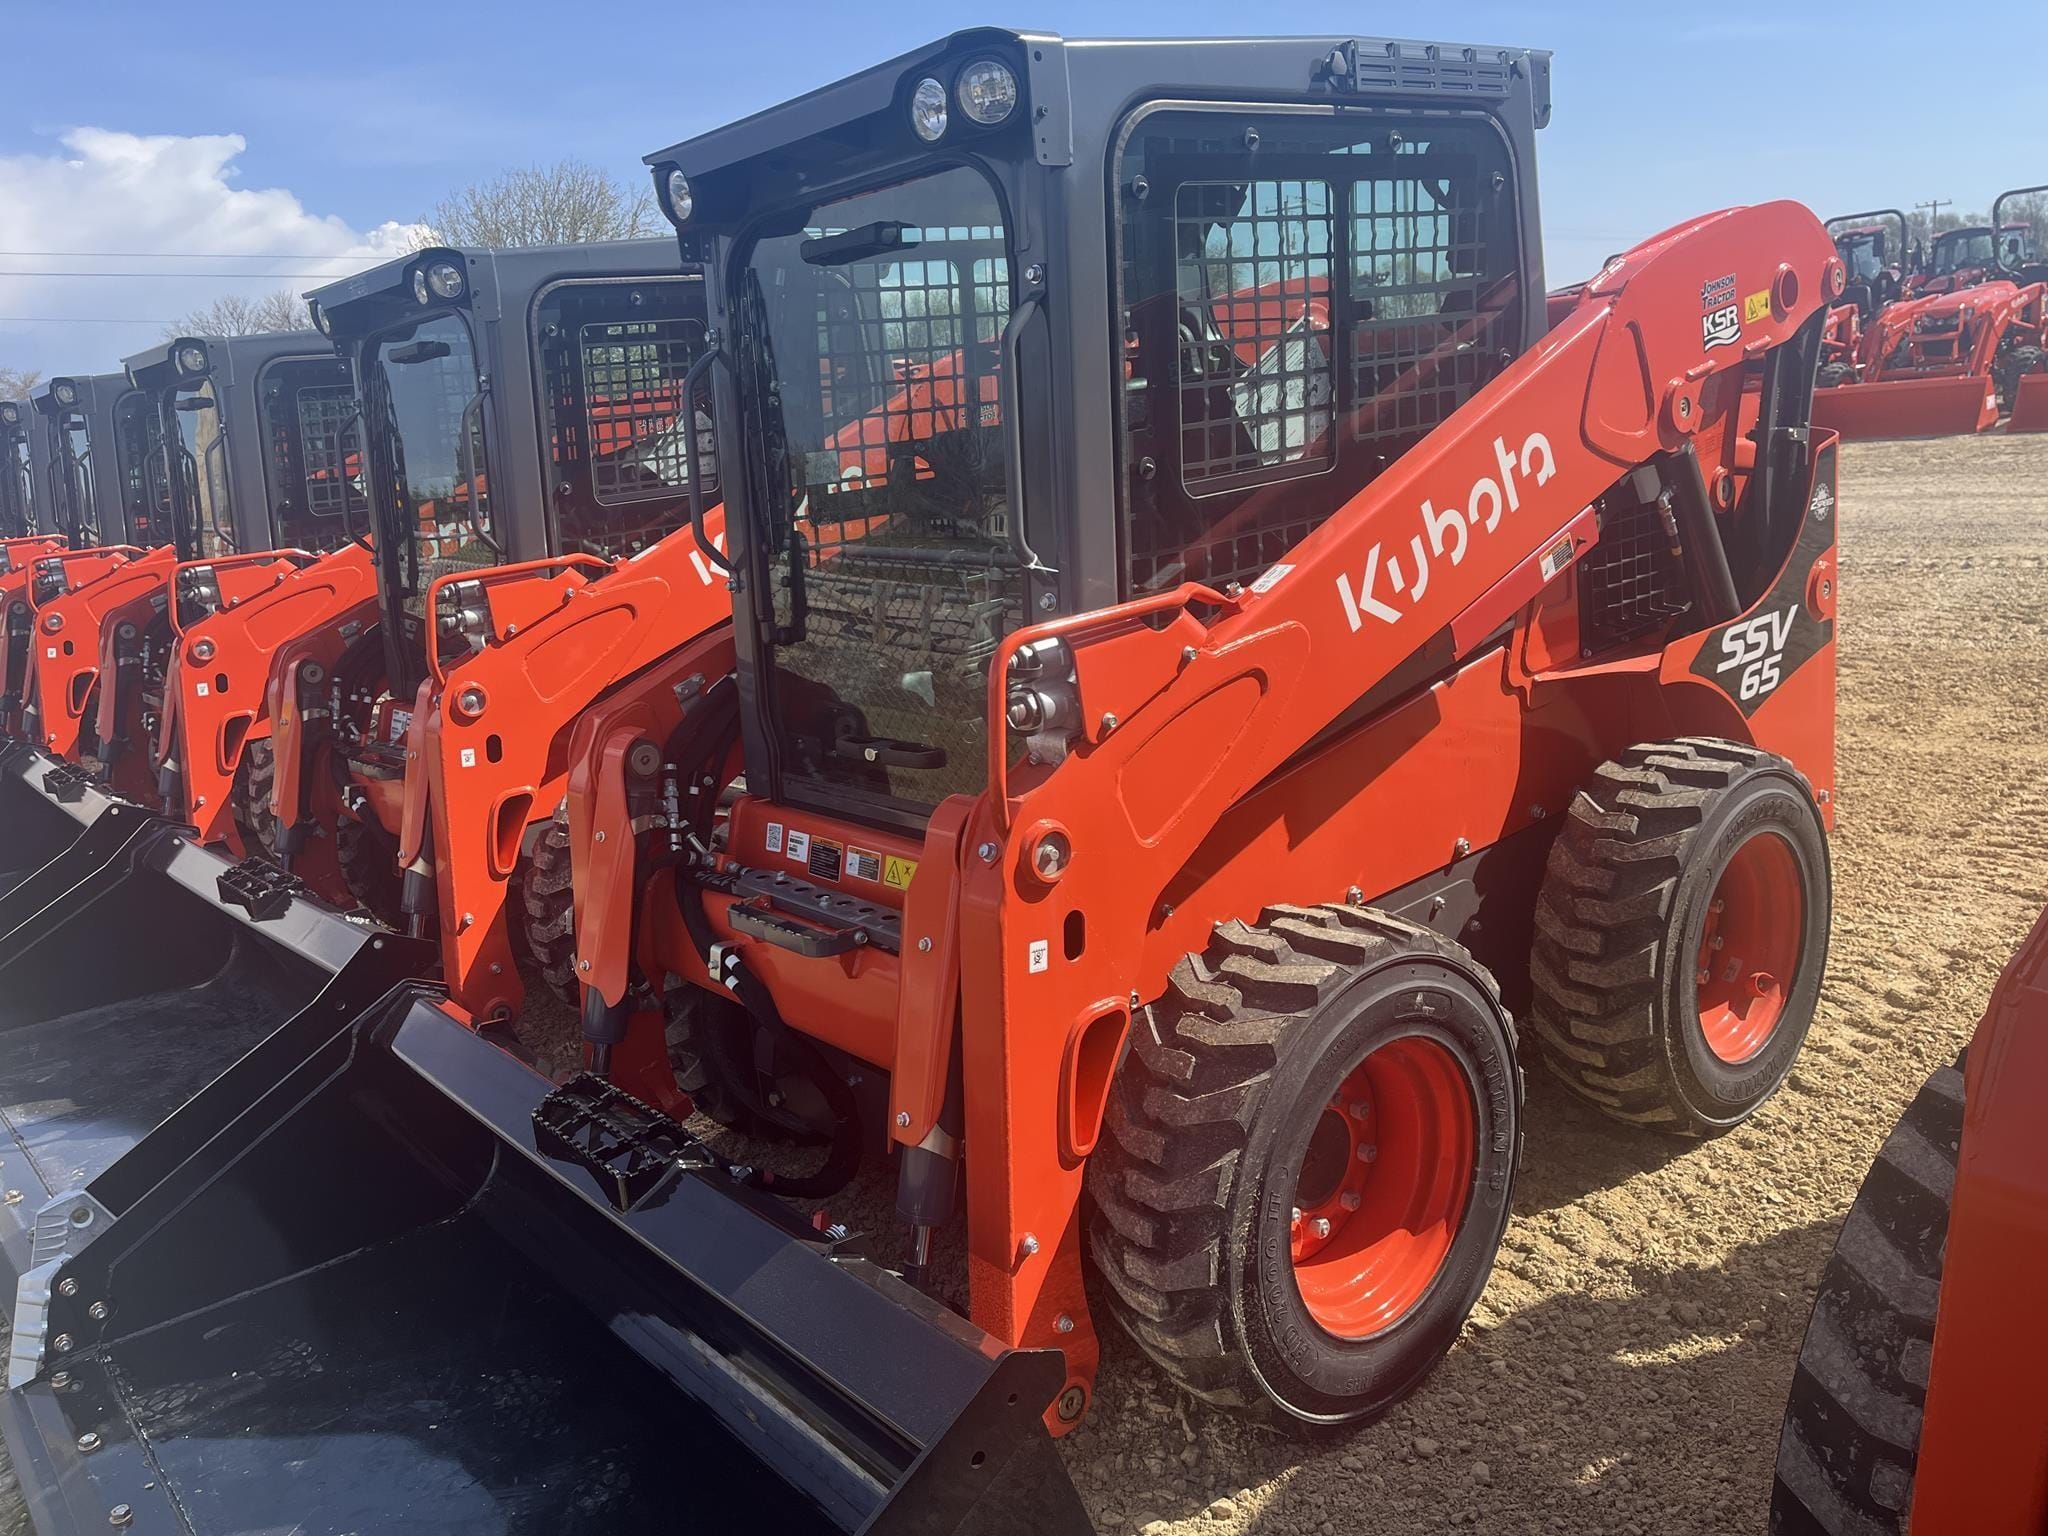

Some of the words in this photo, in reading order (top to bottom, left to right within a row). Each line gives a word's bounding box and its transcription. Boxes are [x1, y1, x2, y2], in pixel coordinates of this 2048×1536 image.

[1701, 273, 1736, 297] JOHNSON
[1701, 289, 1736, 310] TRACTOR
[1703, 305, 1739, 336] KSR
[1336, 432, 1557, 633] Kubota
[1716, 603, 1800, 675] SSV
[1740, 653, 1784, 702] 65
[1482, 1046, 1509, 1155] TITAN
